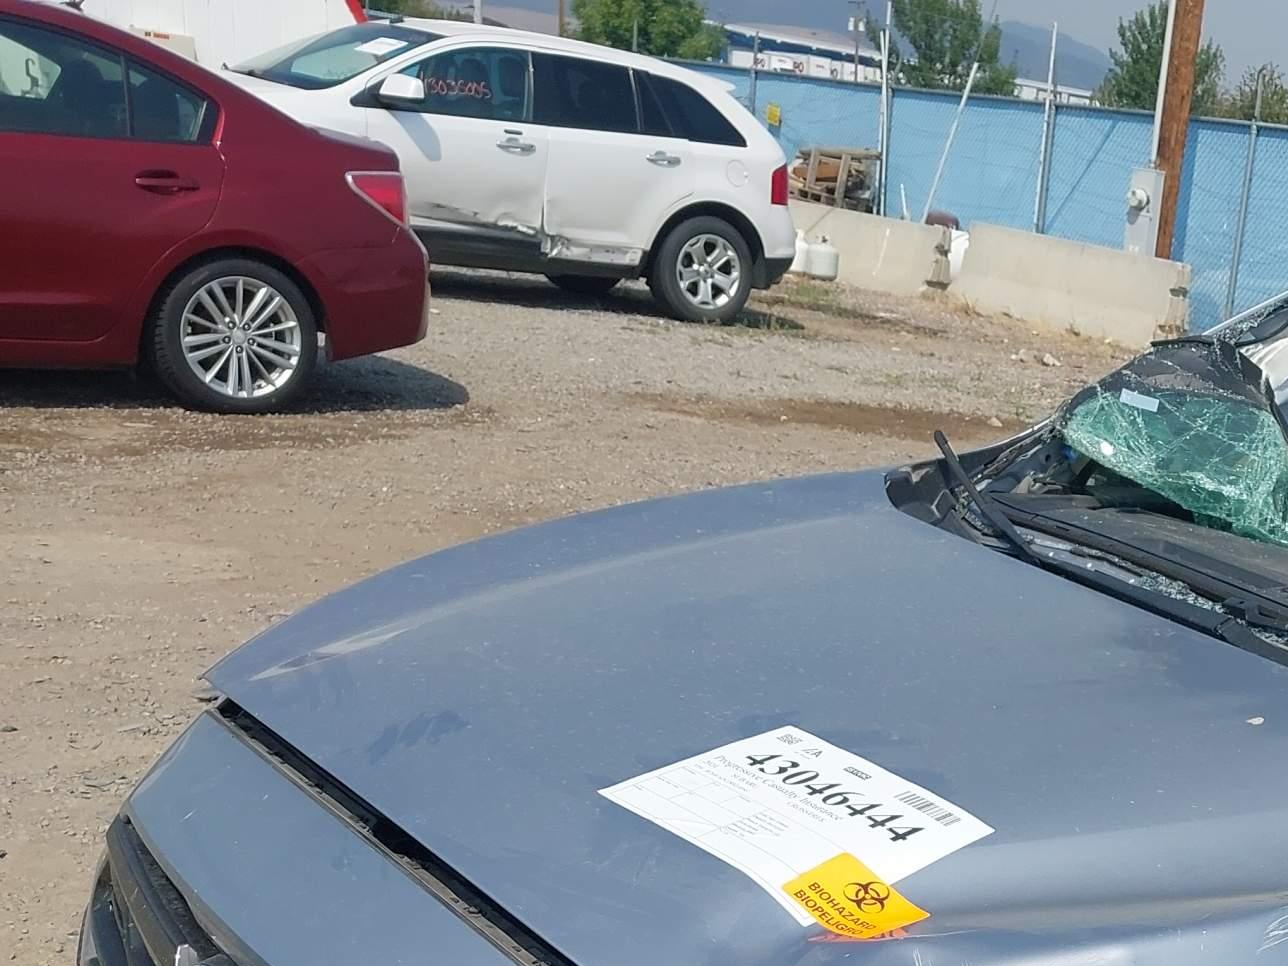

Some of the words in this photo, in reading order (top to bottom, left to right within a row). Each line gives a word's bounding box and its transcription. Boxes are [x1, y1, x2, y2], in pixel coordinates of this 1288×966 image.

[745, 753, 925, 842] 43046444
[793, 889, 864, 935] BIOPELIGRO
[808, 882, 877, 930] BIOHAZARD
